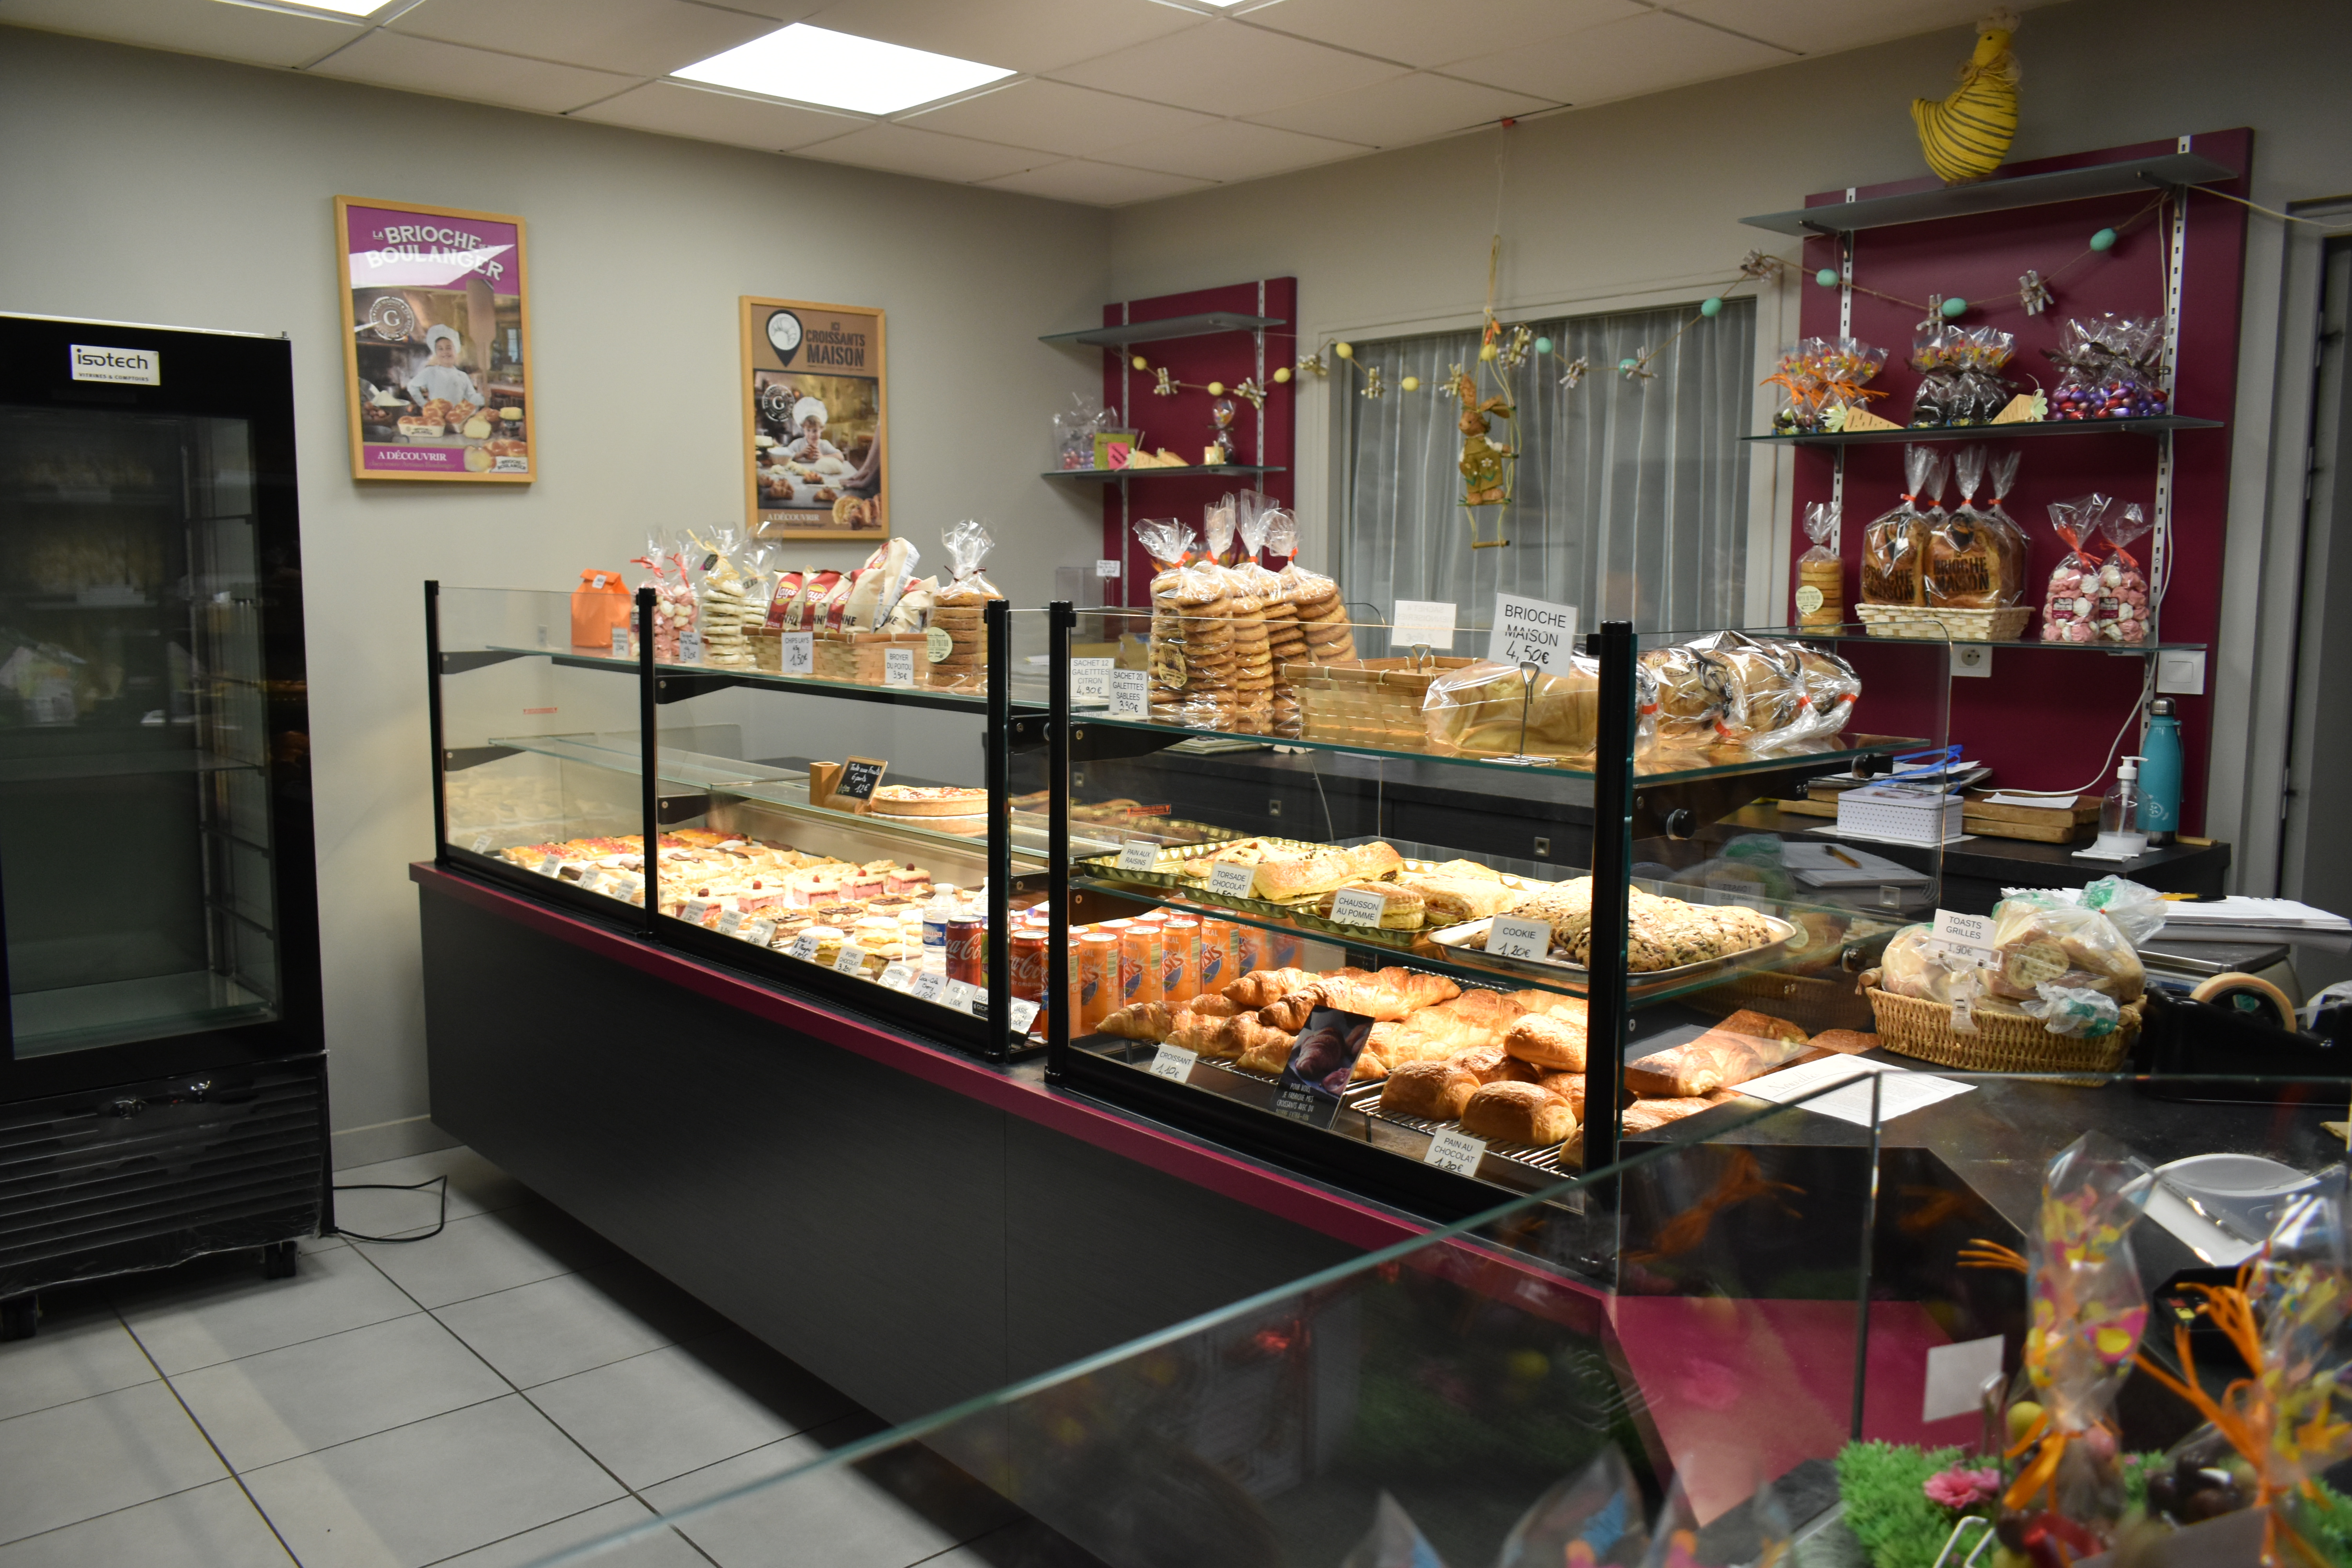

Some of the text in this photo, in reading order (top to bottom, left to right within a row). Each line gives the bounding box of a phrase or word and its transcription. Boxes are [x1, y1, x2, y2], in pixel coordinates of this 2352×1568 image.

[373, 225, 482, 252] LA BRIOCHE
[365, 244, 504, 281] BOULANGER
[383, 310, 400, 327] G
[806, 329, 865, 347] CROISSANTS
[76, 348, 148, 370] isotech
[807, 343, 864, 367] MAISON
[772, 396, 785, 410] G
[377, 450, 447, 461] A DÉCOUVRIR
[774, 511, 820, 521] DÉCOUVRIR
[775, 586, 797, 599] Lay's
[1505, 604, 1566, 628] BRIOCHE
[1505, 624, 1559, 647] MAISON
[1506, 641, 1550, 664] 4,50€
[1114, 671, 1136, 680] SACHET
[1076, 685, 1102, 695] 4,90€
[1112, 681, 1144, 691] GALETTTES
[1116, 691, 1140, 701] SABLEES
[1125, 857, 1147, 866] RAISINS
[1217, 871, 1247, 882] TORSADE
[1212, 879, 1246, 891] CHOCOLAT
[1339, 897, 1379, 911] CHAUSSON
[1348, 909, 1375, 921] POMME
[1949, 916, 1982, 929] TOASTS
[1503, 927, 1537, 939] COOKIE
[1945, 926, 1981, 939] GRILLES
[1498, 942, 1531, 958] 1,20€
[839, 957, 859, 966] CHOCOLAT
[1160, 1051, 1192, 1065] CROISSANT
[1156, 1063, 1179, 1078] 1,10€
[1290, 1082, 1310, 1093] POUR VOUS
[1288, 1092, 1305, 1101] FABRIQUE
[1276, 1099, 1298, 1109] CROISSANTS
[1298, 1102, 1308, 1111] AVEC
[1444, 1137, 1473, 1152] PAIN AU
[1434, 1145, 1475, 1163] CHOCOLAT
